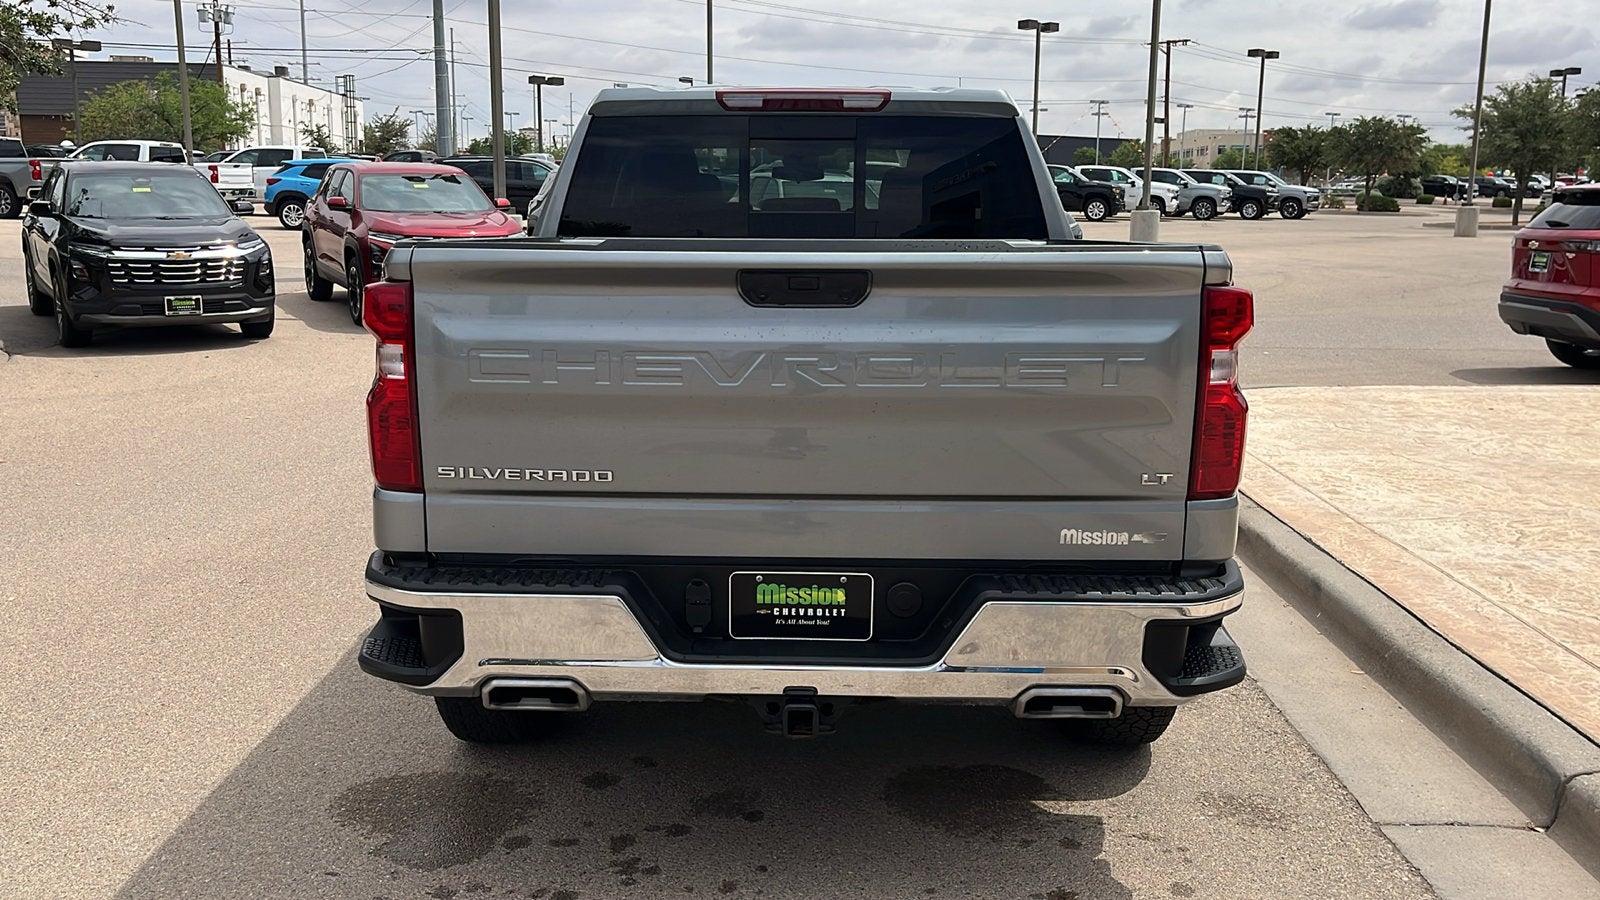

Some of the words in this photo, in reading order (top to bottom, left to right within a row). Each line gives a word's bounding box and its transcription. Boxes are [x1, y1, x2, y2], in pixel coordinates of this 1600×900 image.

[468, 347, 1146, 388] CHEVROLET
[437, 466, 614, 482] SILVERADO
[1141, 473, 1174, 485] LT
[1060, 528, 1129, 545] Mission
[756, 583, 846, 605] Mission
[773, 607, 846, 617] CHEVROLET
